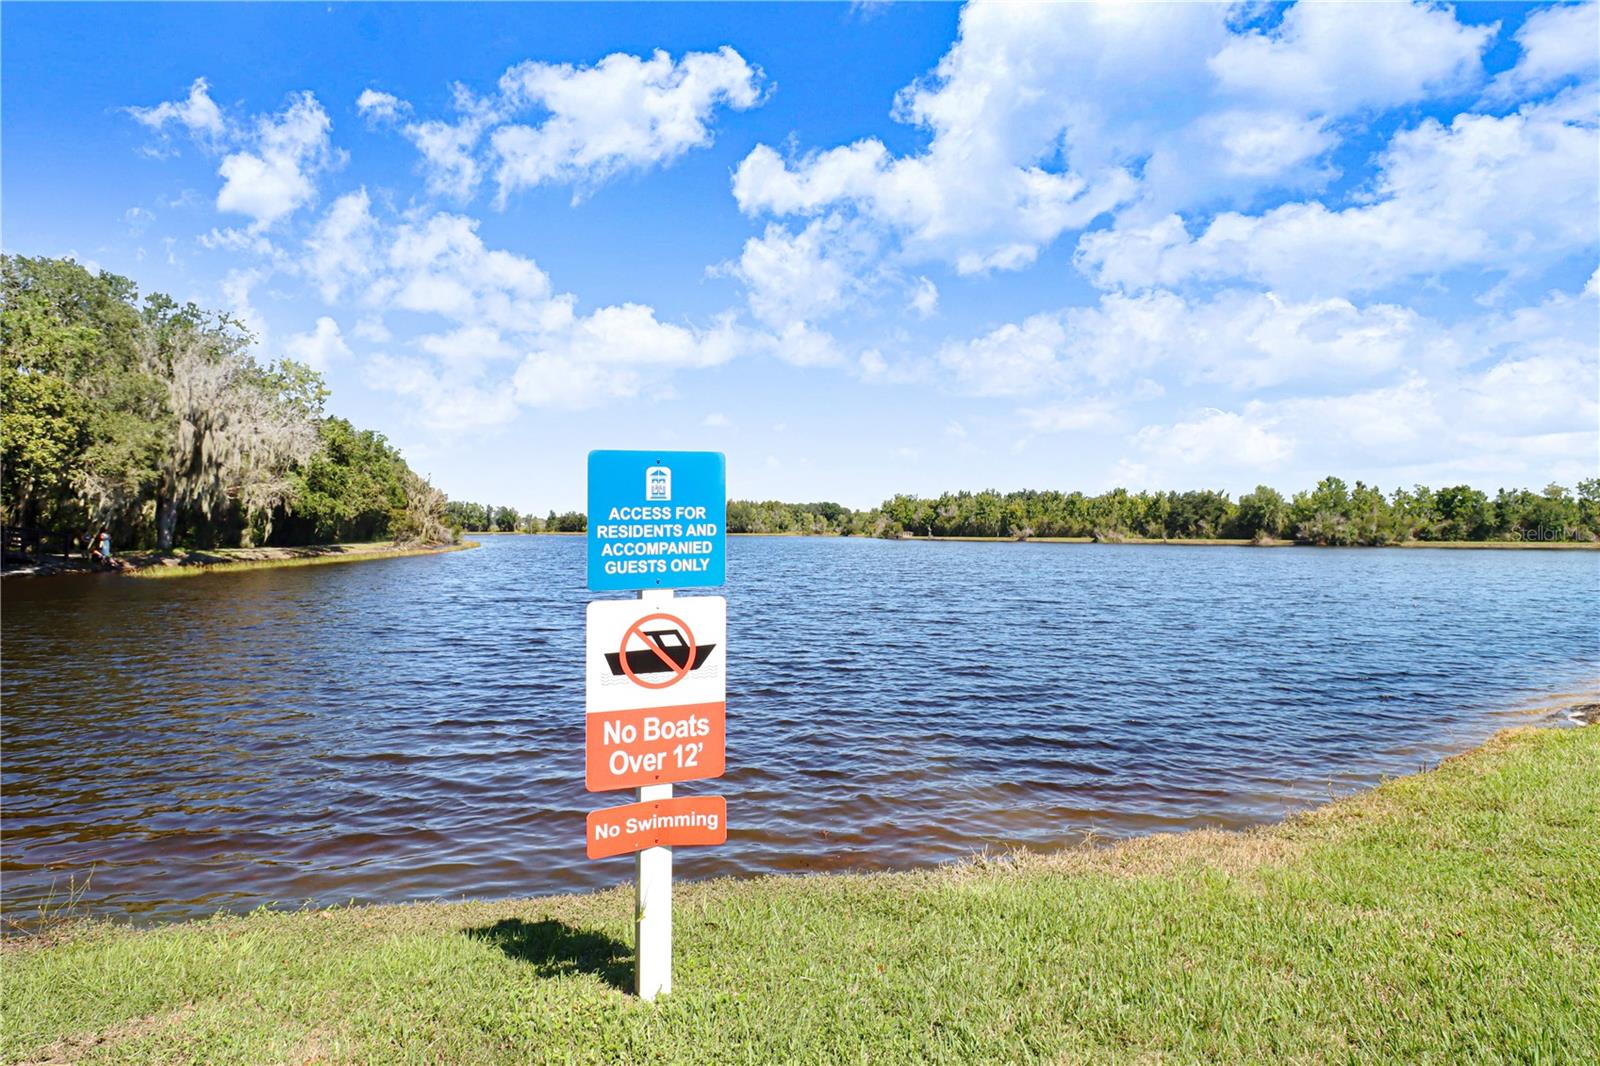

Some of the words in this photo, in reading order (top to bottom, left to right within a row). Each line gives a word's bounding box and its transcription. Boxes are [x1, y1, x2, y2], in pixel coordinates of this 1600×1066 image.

[608, 506, 672, 520] ACCESS
[675, 506, 706, 520] FOR
[597, 524, 682, 539] RESIDENTS
[686, 523, 717, 537] AND
[601, 541, 713, 557] ACCOMPANIED
[604, 559, 667, 575] GUESTS
[670, 558, 710, 572] ONLY
[603, 719, 637, 745] No
[643, 714, 710, 742] Boats
[609, 751, 667, 776] Over
[595, 823, 621, 840] No
[625, 811, 719, 833] Swimming
